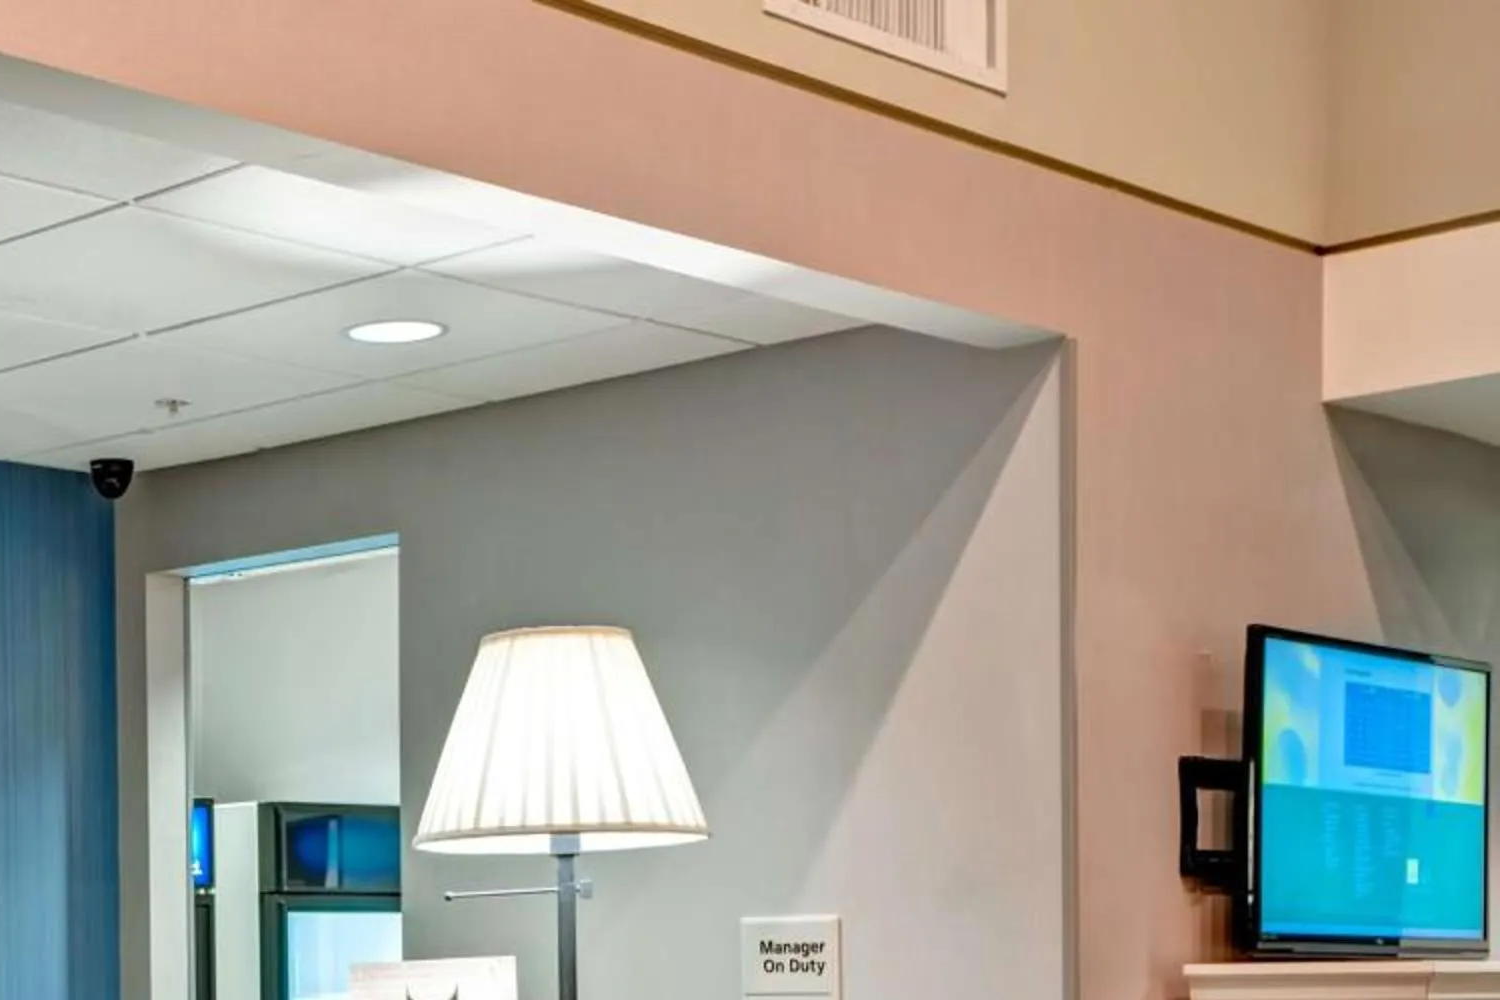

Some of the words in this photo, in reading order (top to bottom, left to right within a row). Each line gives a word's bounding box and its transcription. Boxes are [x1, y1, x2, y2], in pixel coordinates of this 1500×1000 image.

[758, 940, 826, 957] Manager
[763, 959, 785, 973] On
[789, 959, 826, 976] Duty
